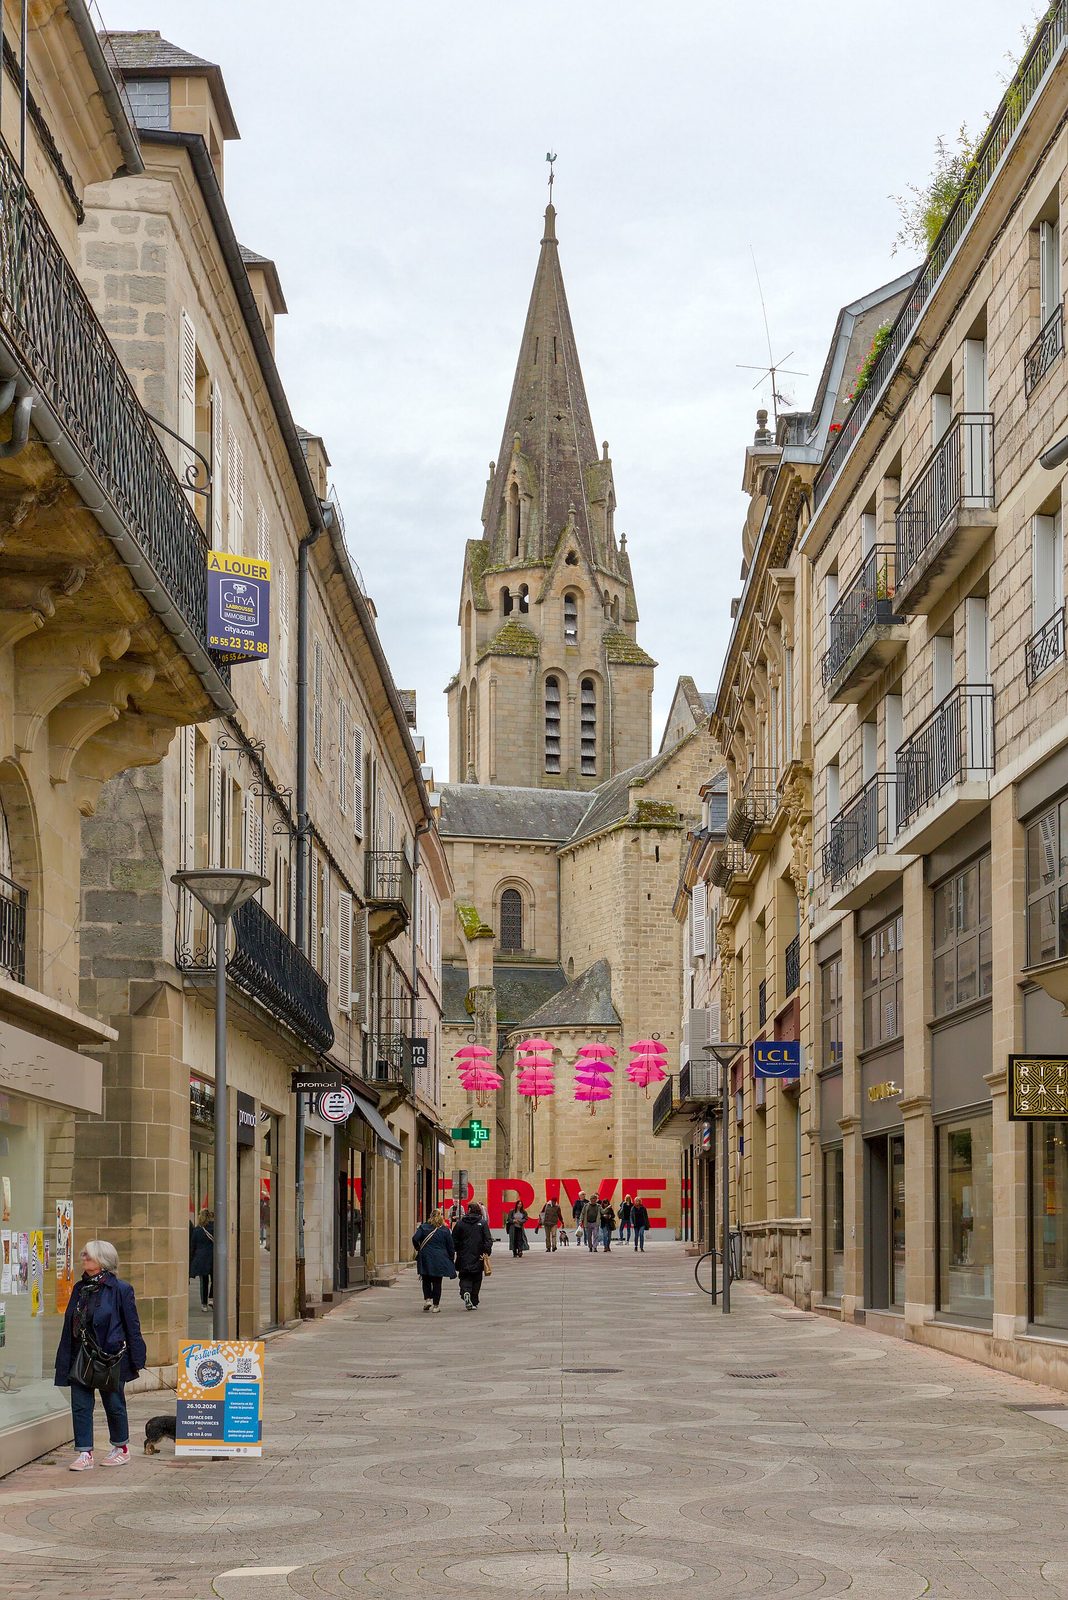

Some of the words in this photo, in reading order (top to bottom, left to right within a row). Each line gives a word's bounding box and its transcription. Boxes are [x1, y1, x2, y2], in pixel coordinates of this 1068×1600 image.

[210, 554, 220, 570] À
[225, 560, 267, 579] LOUER
[224, 611, 256, 623] IMMOBILIER
[224, 624, 254, 636] citya.com
[210, 636, 218, 644] 05
[220, 638, 228, 646] 55
[230, 637, 241, 648] 23
[244, 639, 254, 651] 32
[257, 642, 268, 653] 88
[758, 1050, 795, 1062] LCL
[182, 1344, 221, 1368] Festival
